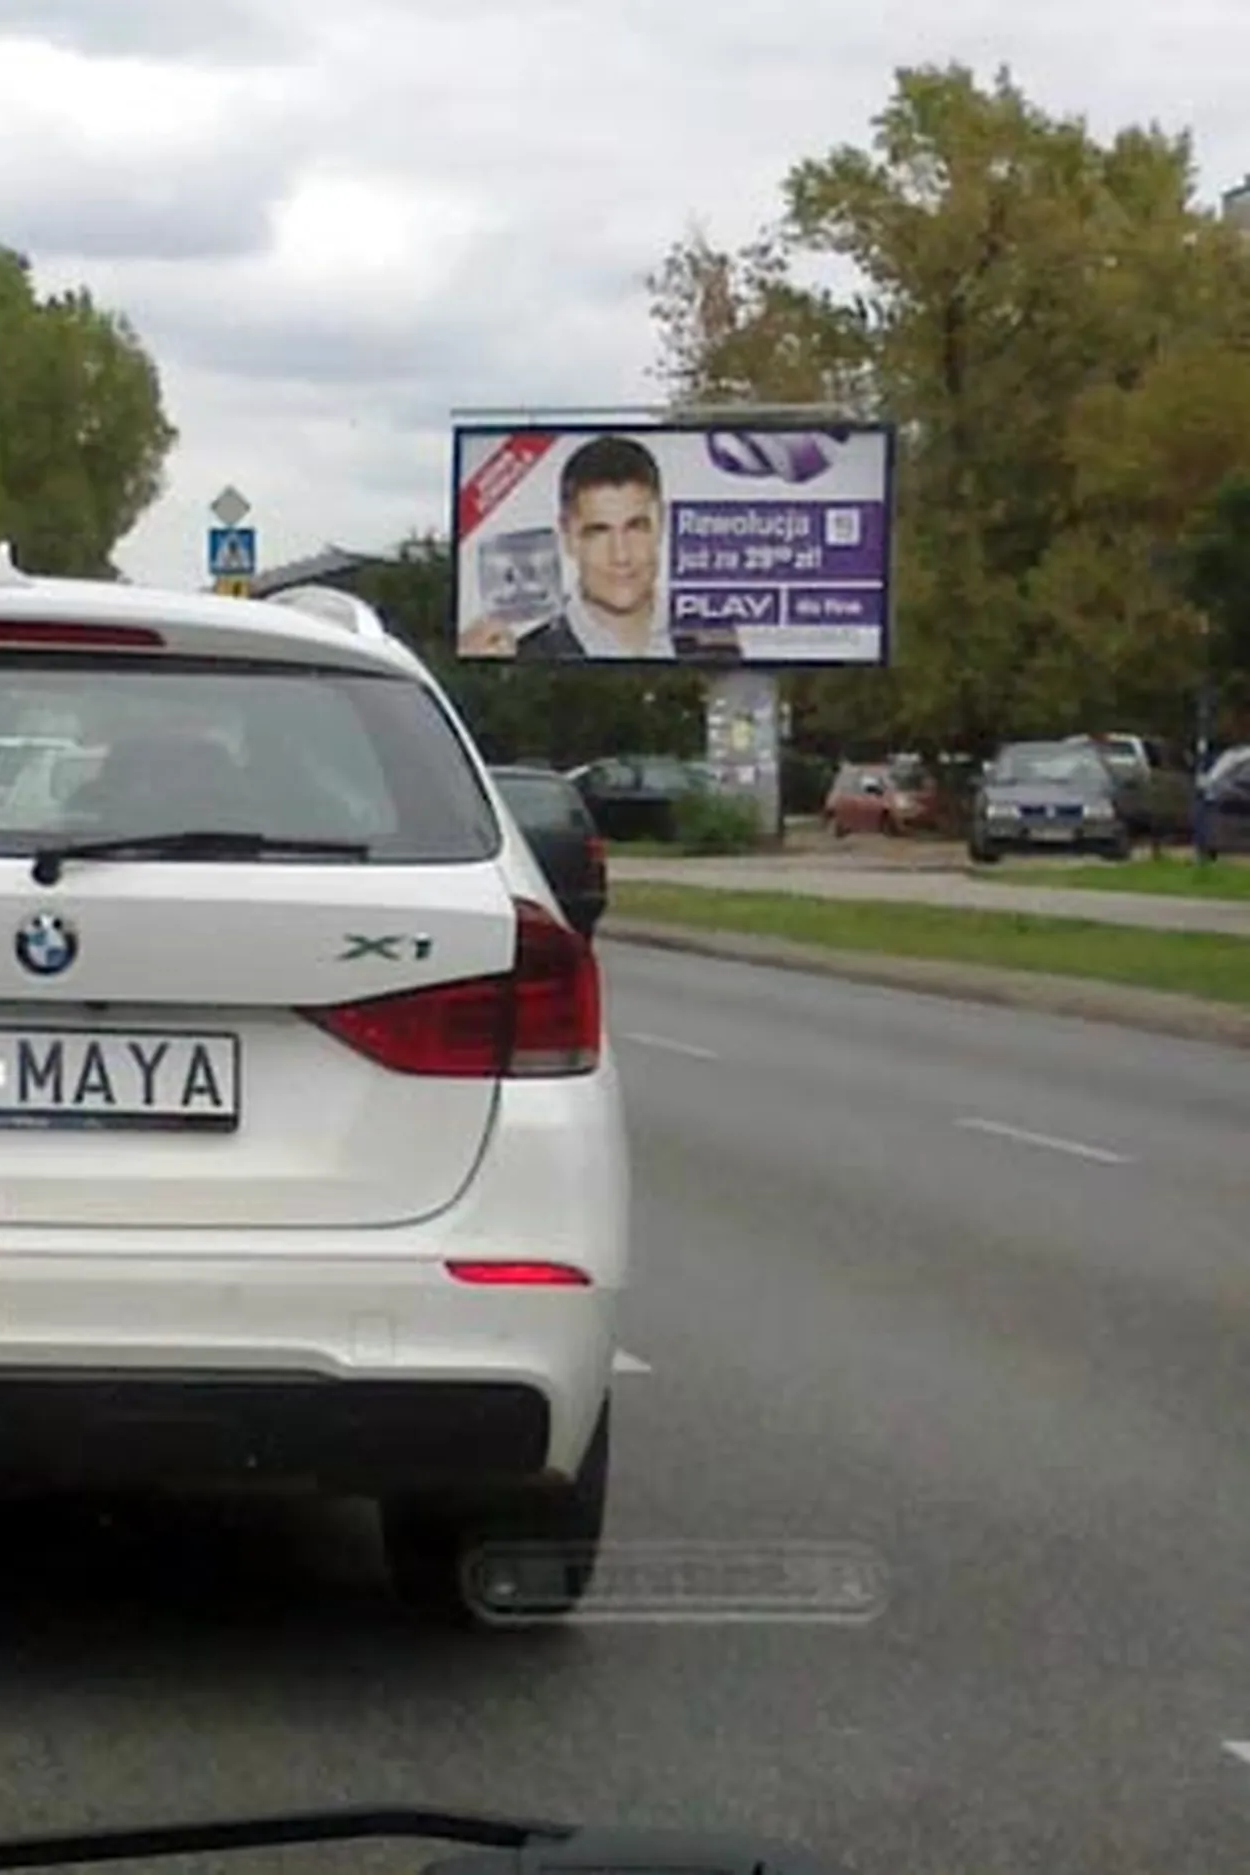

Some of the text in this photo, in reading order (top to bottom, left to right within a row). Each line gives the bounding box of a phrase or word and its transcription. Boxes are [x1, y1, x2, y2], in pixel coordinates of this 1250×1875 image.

[676, 594, 774, 619] PLAY
[337, 932, 433, 960] X1
[17, 1039, 223, 1107] MAYA
